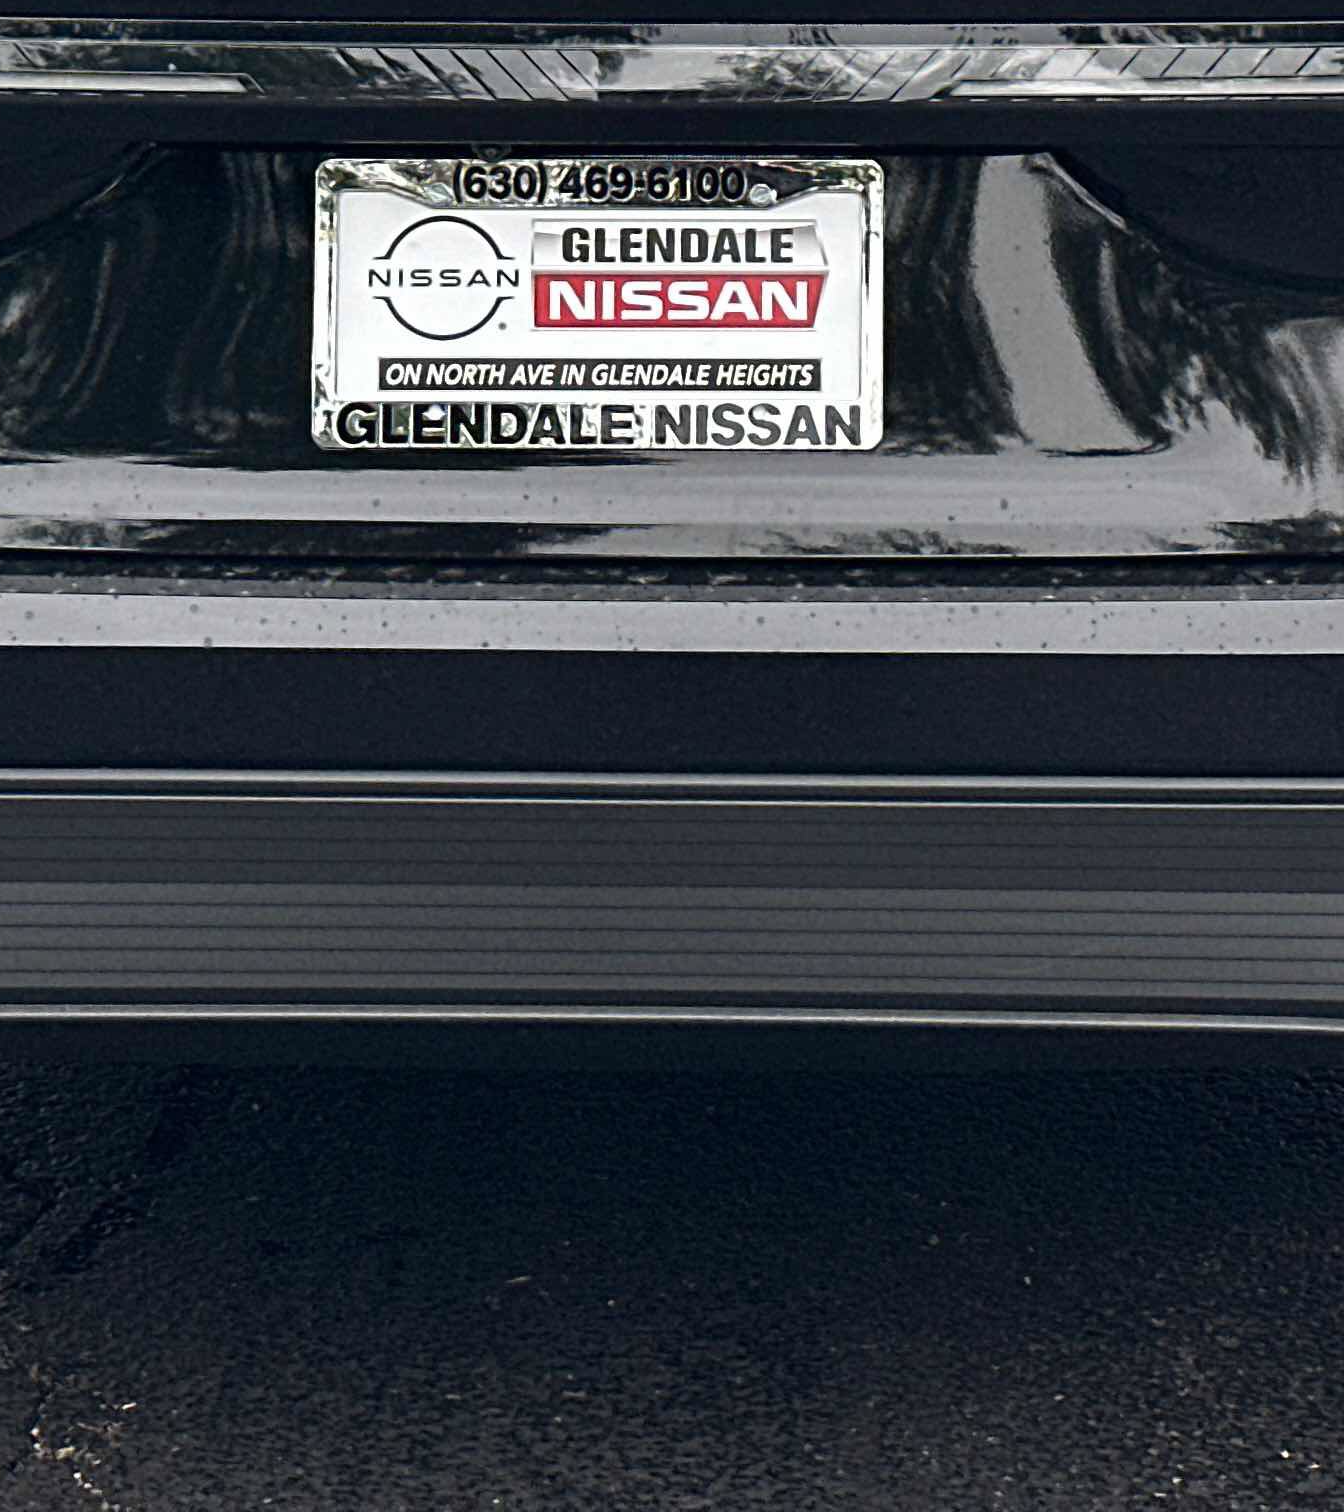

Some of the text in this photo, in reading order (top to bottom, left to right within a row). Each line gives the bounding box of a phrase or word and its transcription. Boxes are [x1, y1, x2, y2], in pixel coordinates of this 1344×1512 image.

[453, 162, 745, 203] (630) 469-6100
[561, 228, 794, 263] GLENDALE
[368, 269, 519, 288] NISSAN
[549, 281, 809, 321] NISSAN
[385, 363, 814, 386] ON NORTH AVE IN GLENDALE HEIGHTS
[336, 401, 862, 446] GLENDALE NISSAN
